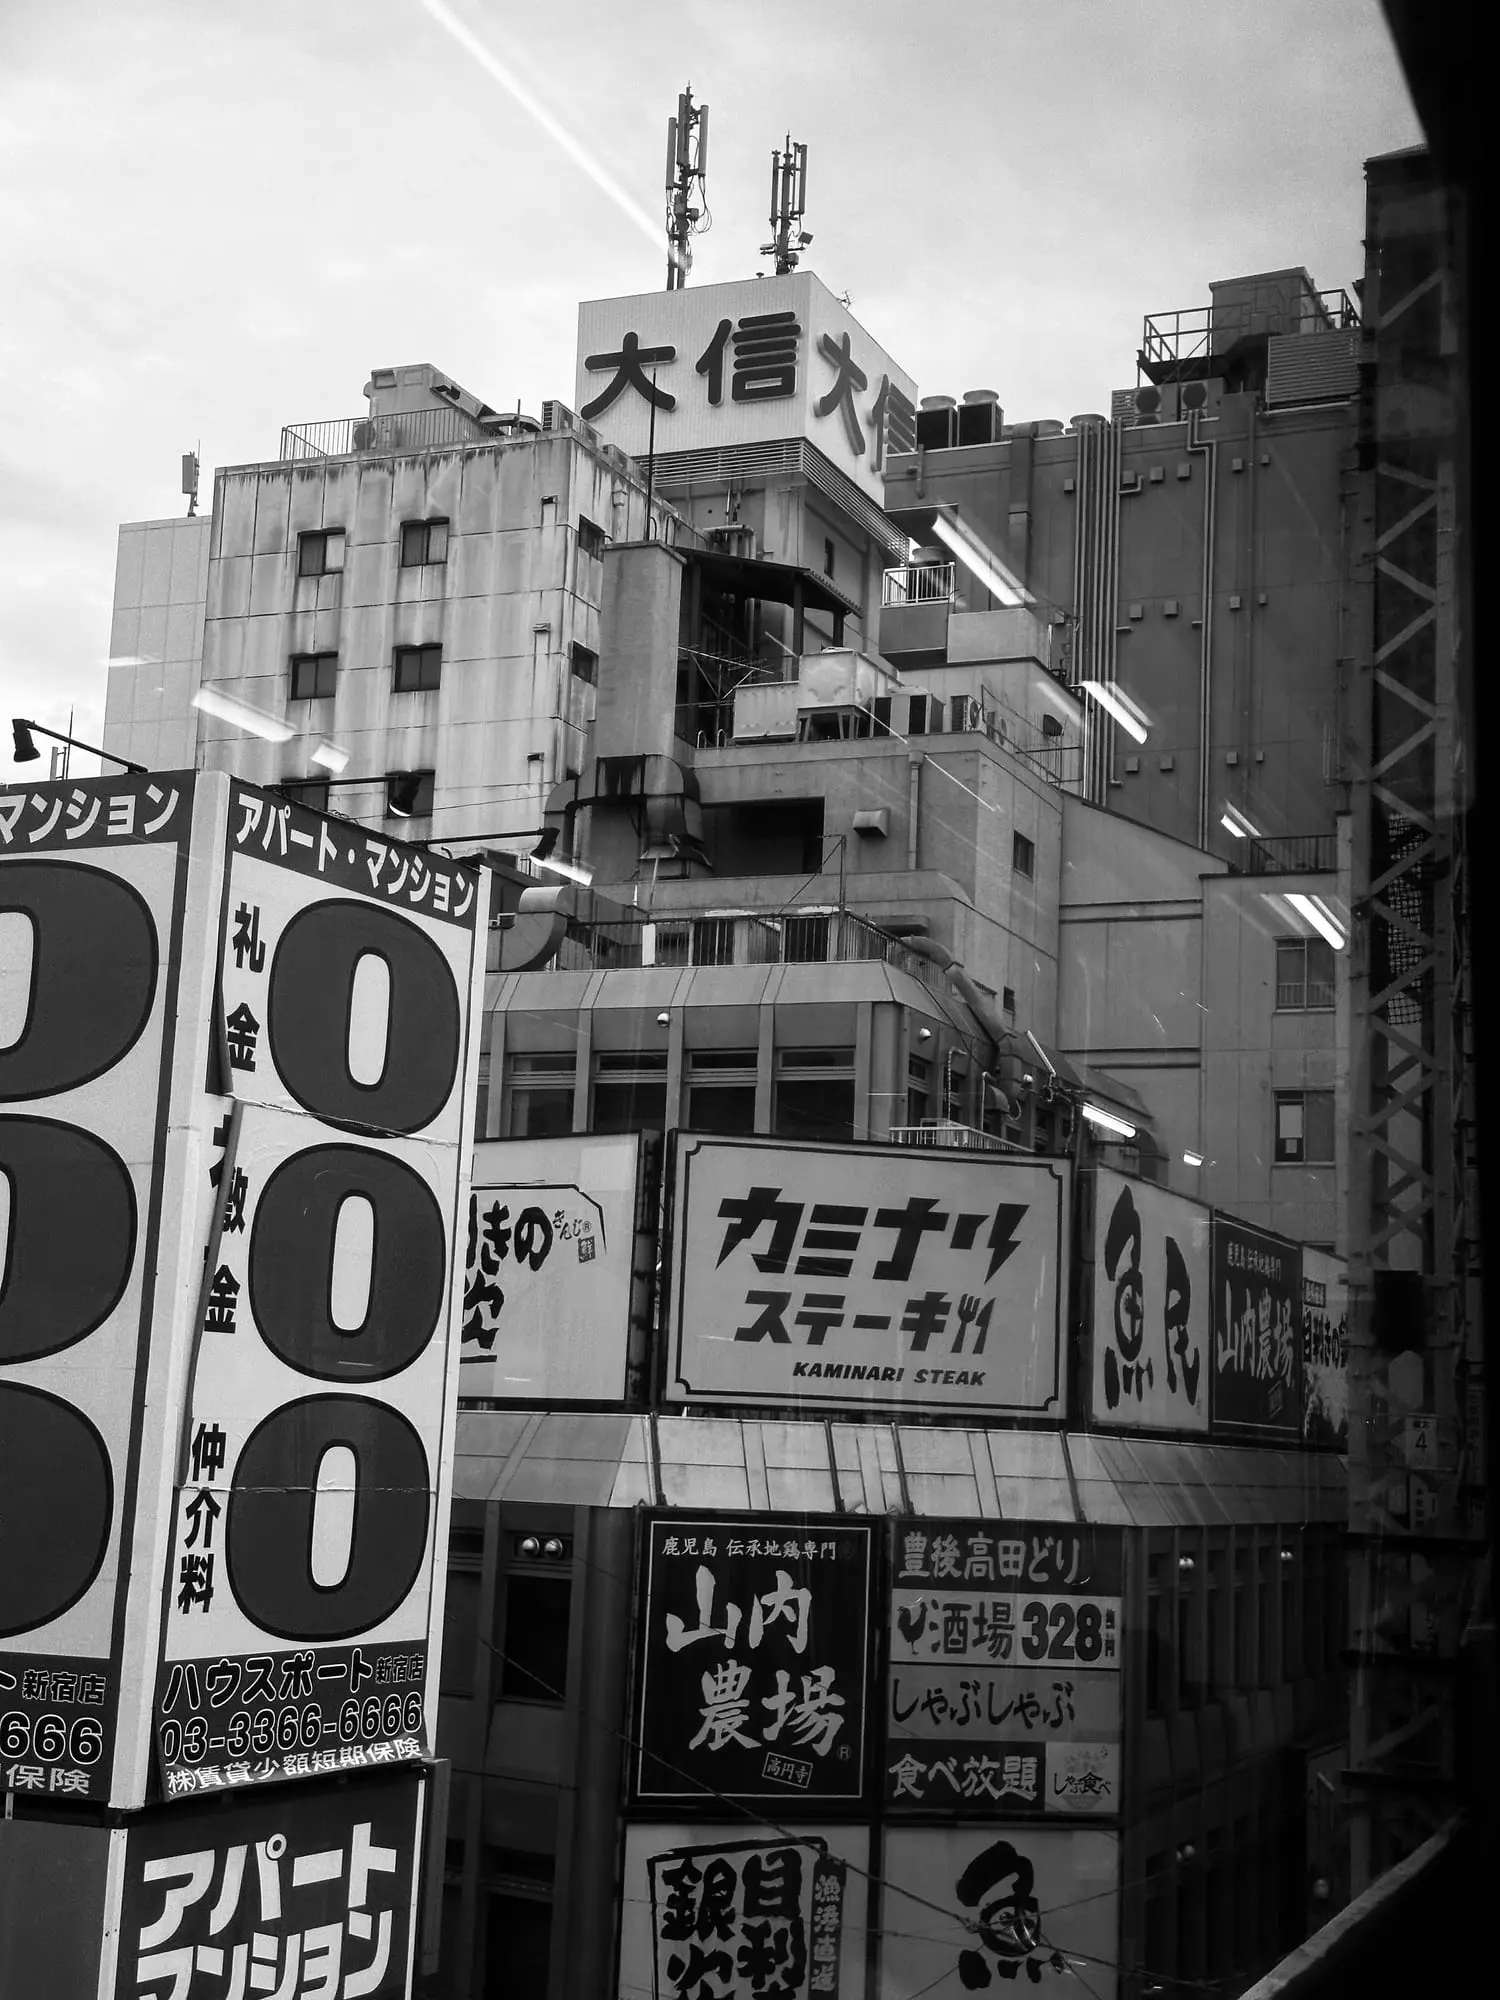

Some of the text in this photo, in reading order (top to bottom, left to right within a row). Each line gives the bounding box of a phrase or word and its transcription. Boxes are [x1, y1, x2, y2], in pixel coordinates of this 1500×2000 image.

[581, 311, 801, 420] 大信
[815, 331, 916, 473] 大信
[236, 793, 474, 918] アパート・マンション
[226, 901, 266, 1073] 礼金
[716, 1186, 1031, 1286] カミナリ
[734, 1290, 952, 1352] ステーキ
[1218, 1279, 1294, 1388] 山内農場
[793, 1361, 986, 1387] KAMINARI STEAK
[178, 1422, 226, 1613] 仲介料
[661, 1535, 837, 1560] 鹿児島 伝承地鶏専門
[897, 1530, 1080, 1585] 豊後高田どり
[665, 1565, 812, 1654] 山内
[1021, 1601, 1104, 1662] 328
[160, 1691, 422, 1766] 03-3366-6666
[688, 1660, 845, 1757] 農場
[892, 1678, 1075, 1730] しゃぶしゃぶ
[6, 1764, 92, 1794] 保険
[766, 1756, 809, 1784] 高円寺
[888, 1751, 1038, 1802] 食べ放題
[138, 1822, 397, 1950] アパート
[811, 1873, 841, 1991] 漁港直送
